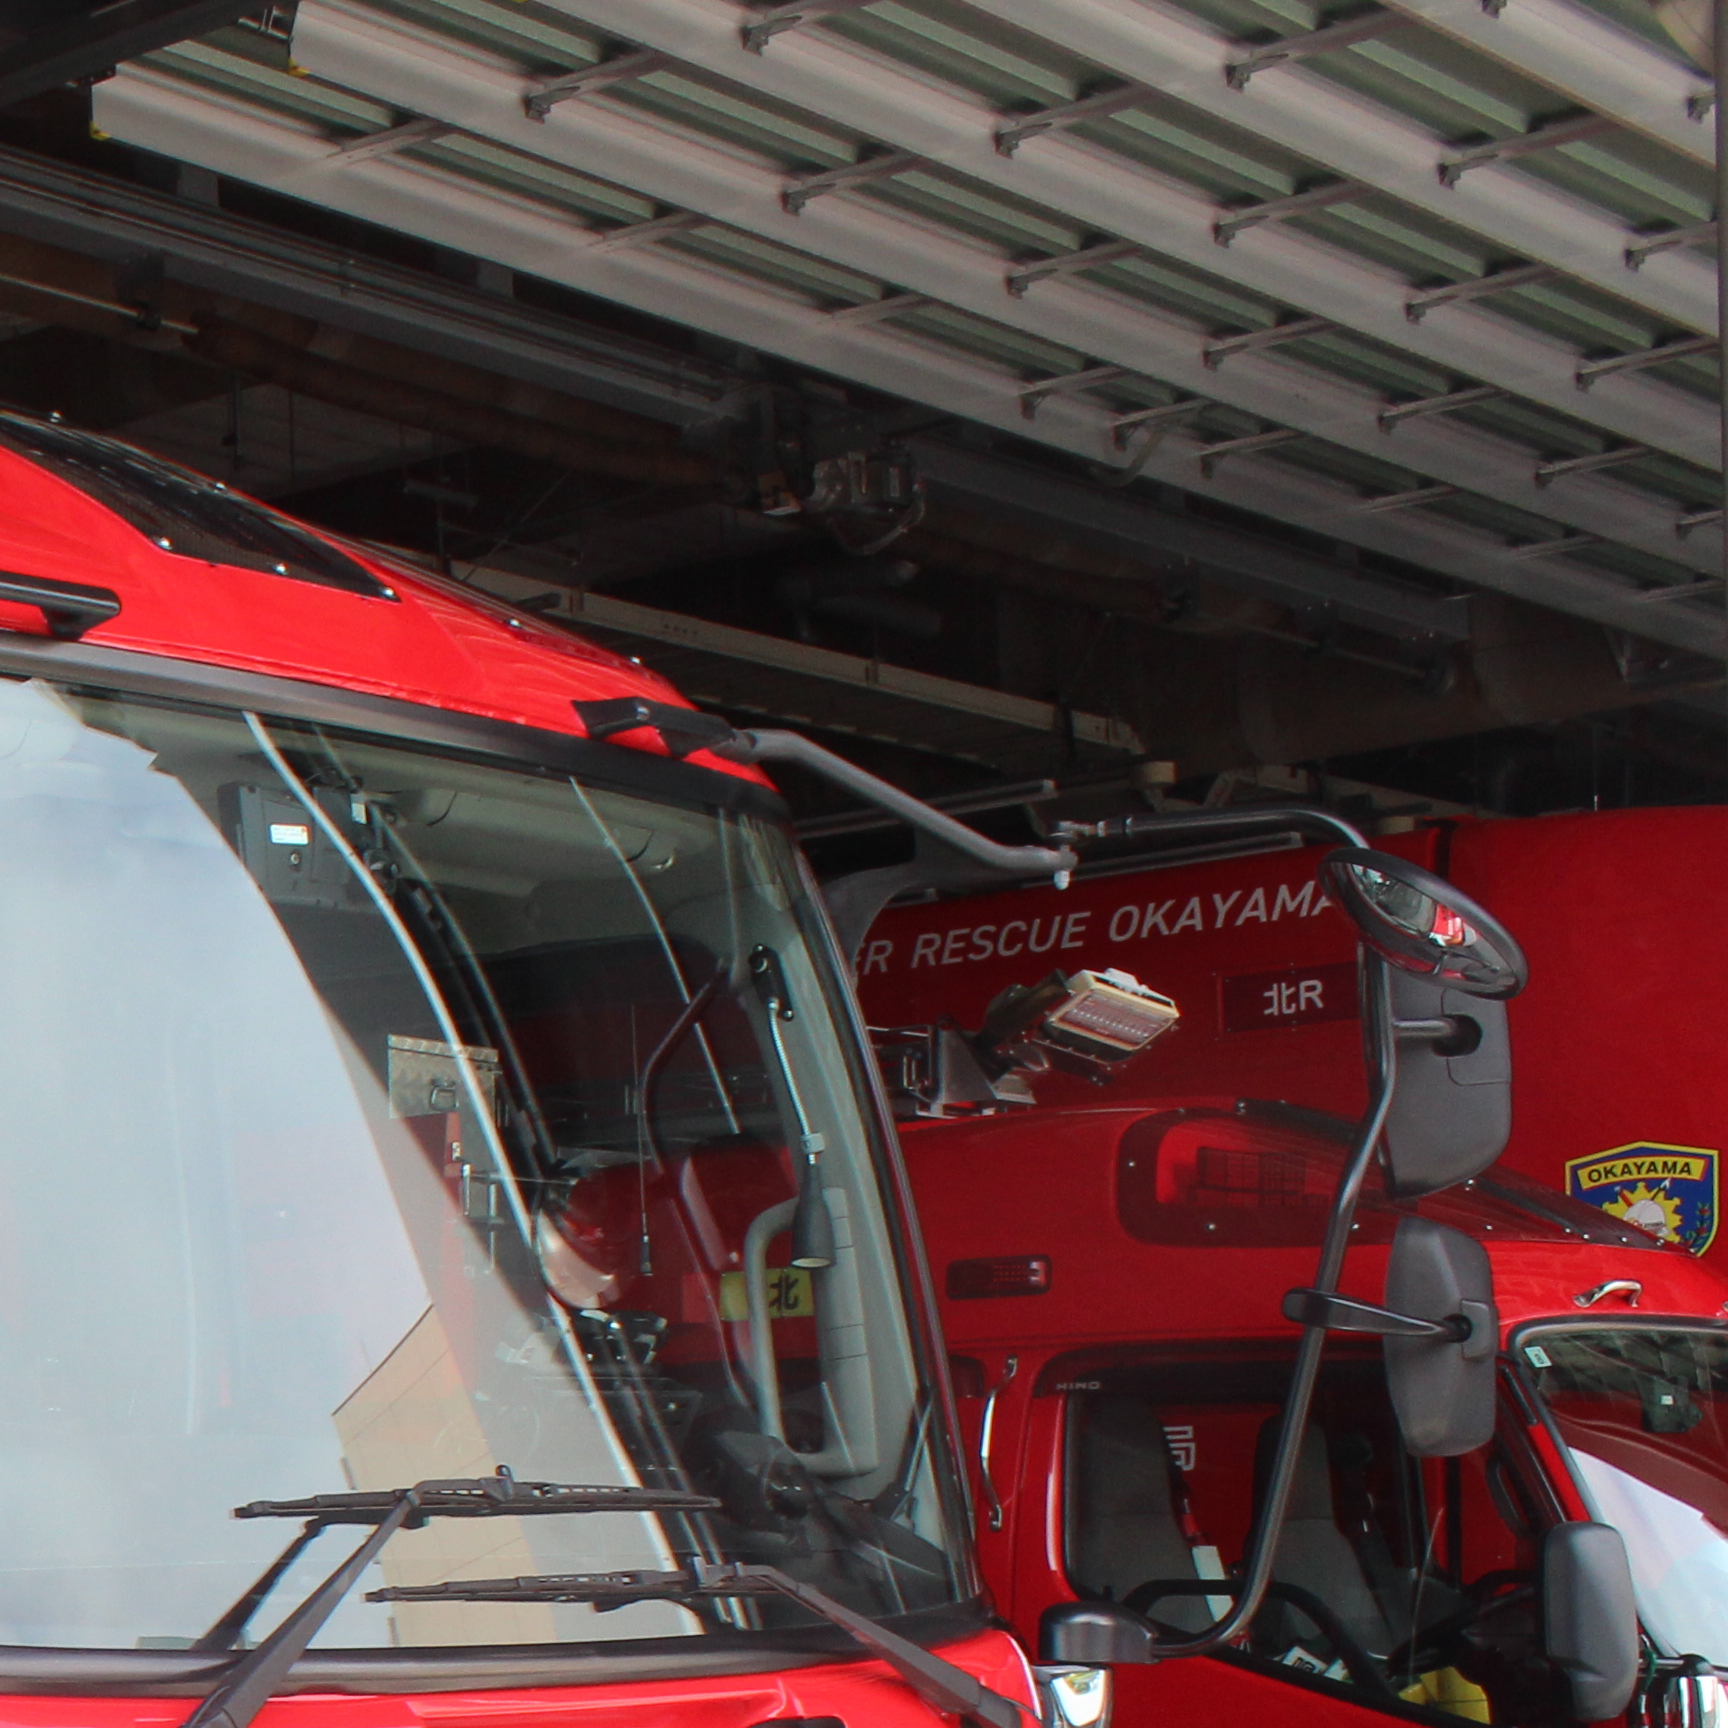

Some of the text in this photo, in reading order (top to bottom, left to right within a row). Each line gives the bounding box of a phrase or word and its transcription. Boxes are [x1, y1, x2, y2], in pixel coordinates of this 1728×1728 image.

[910, 911, 1092, 969] RESCUE
[1263, 978, 1325, 1017] 北R
[1587, 1159, 1694, 1184] OKAYAMA
